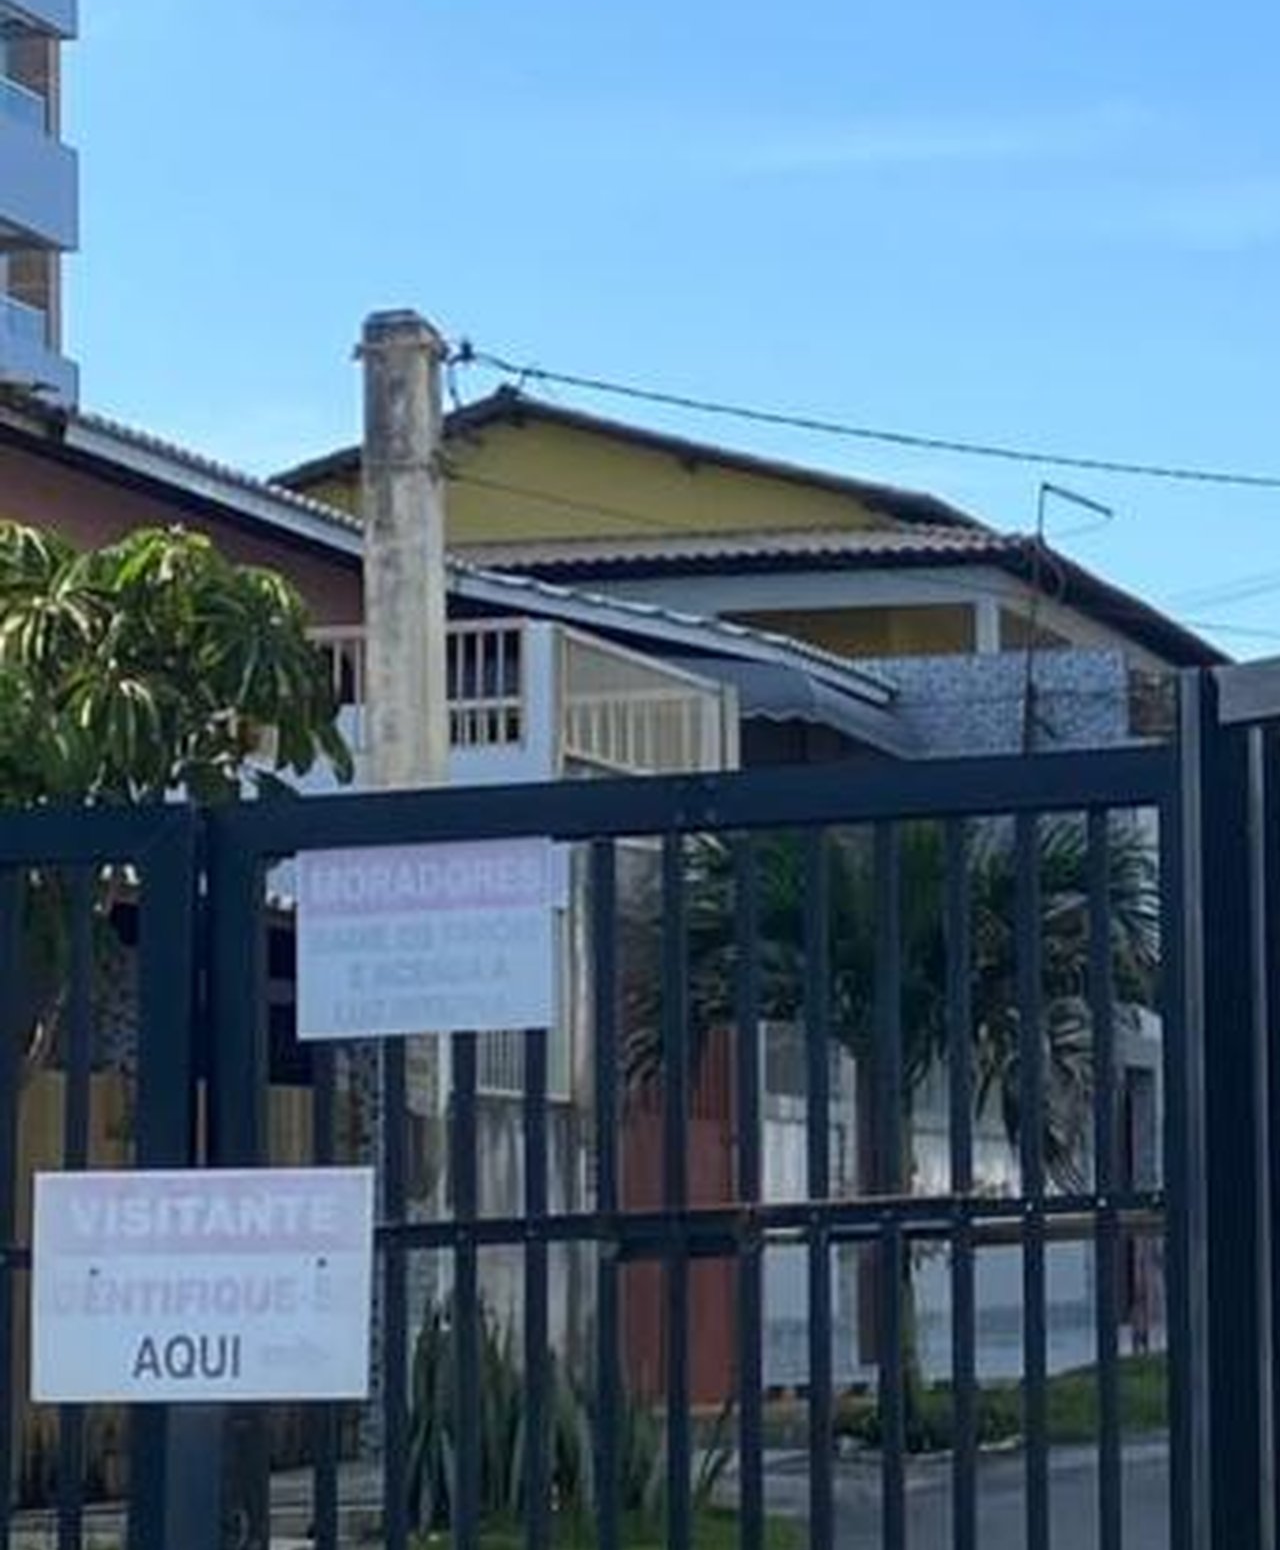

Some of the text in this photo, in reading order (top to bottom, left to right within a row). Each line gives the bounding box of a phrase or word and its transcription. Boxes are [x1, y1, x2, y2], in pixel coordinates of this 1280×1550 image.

[310, 857, 542, 904] MORADORES
[70, 1194, 338, 1239] VISITANTE
[131, 1333, 243, 1380] AQUI
